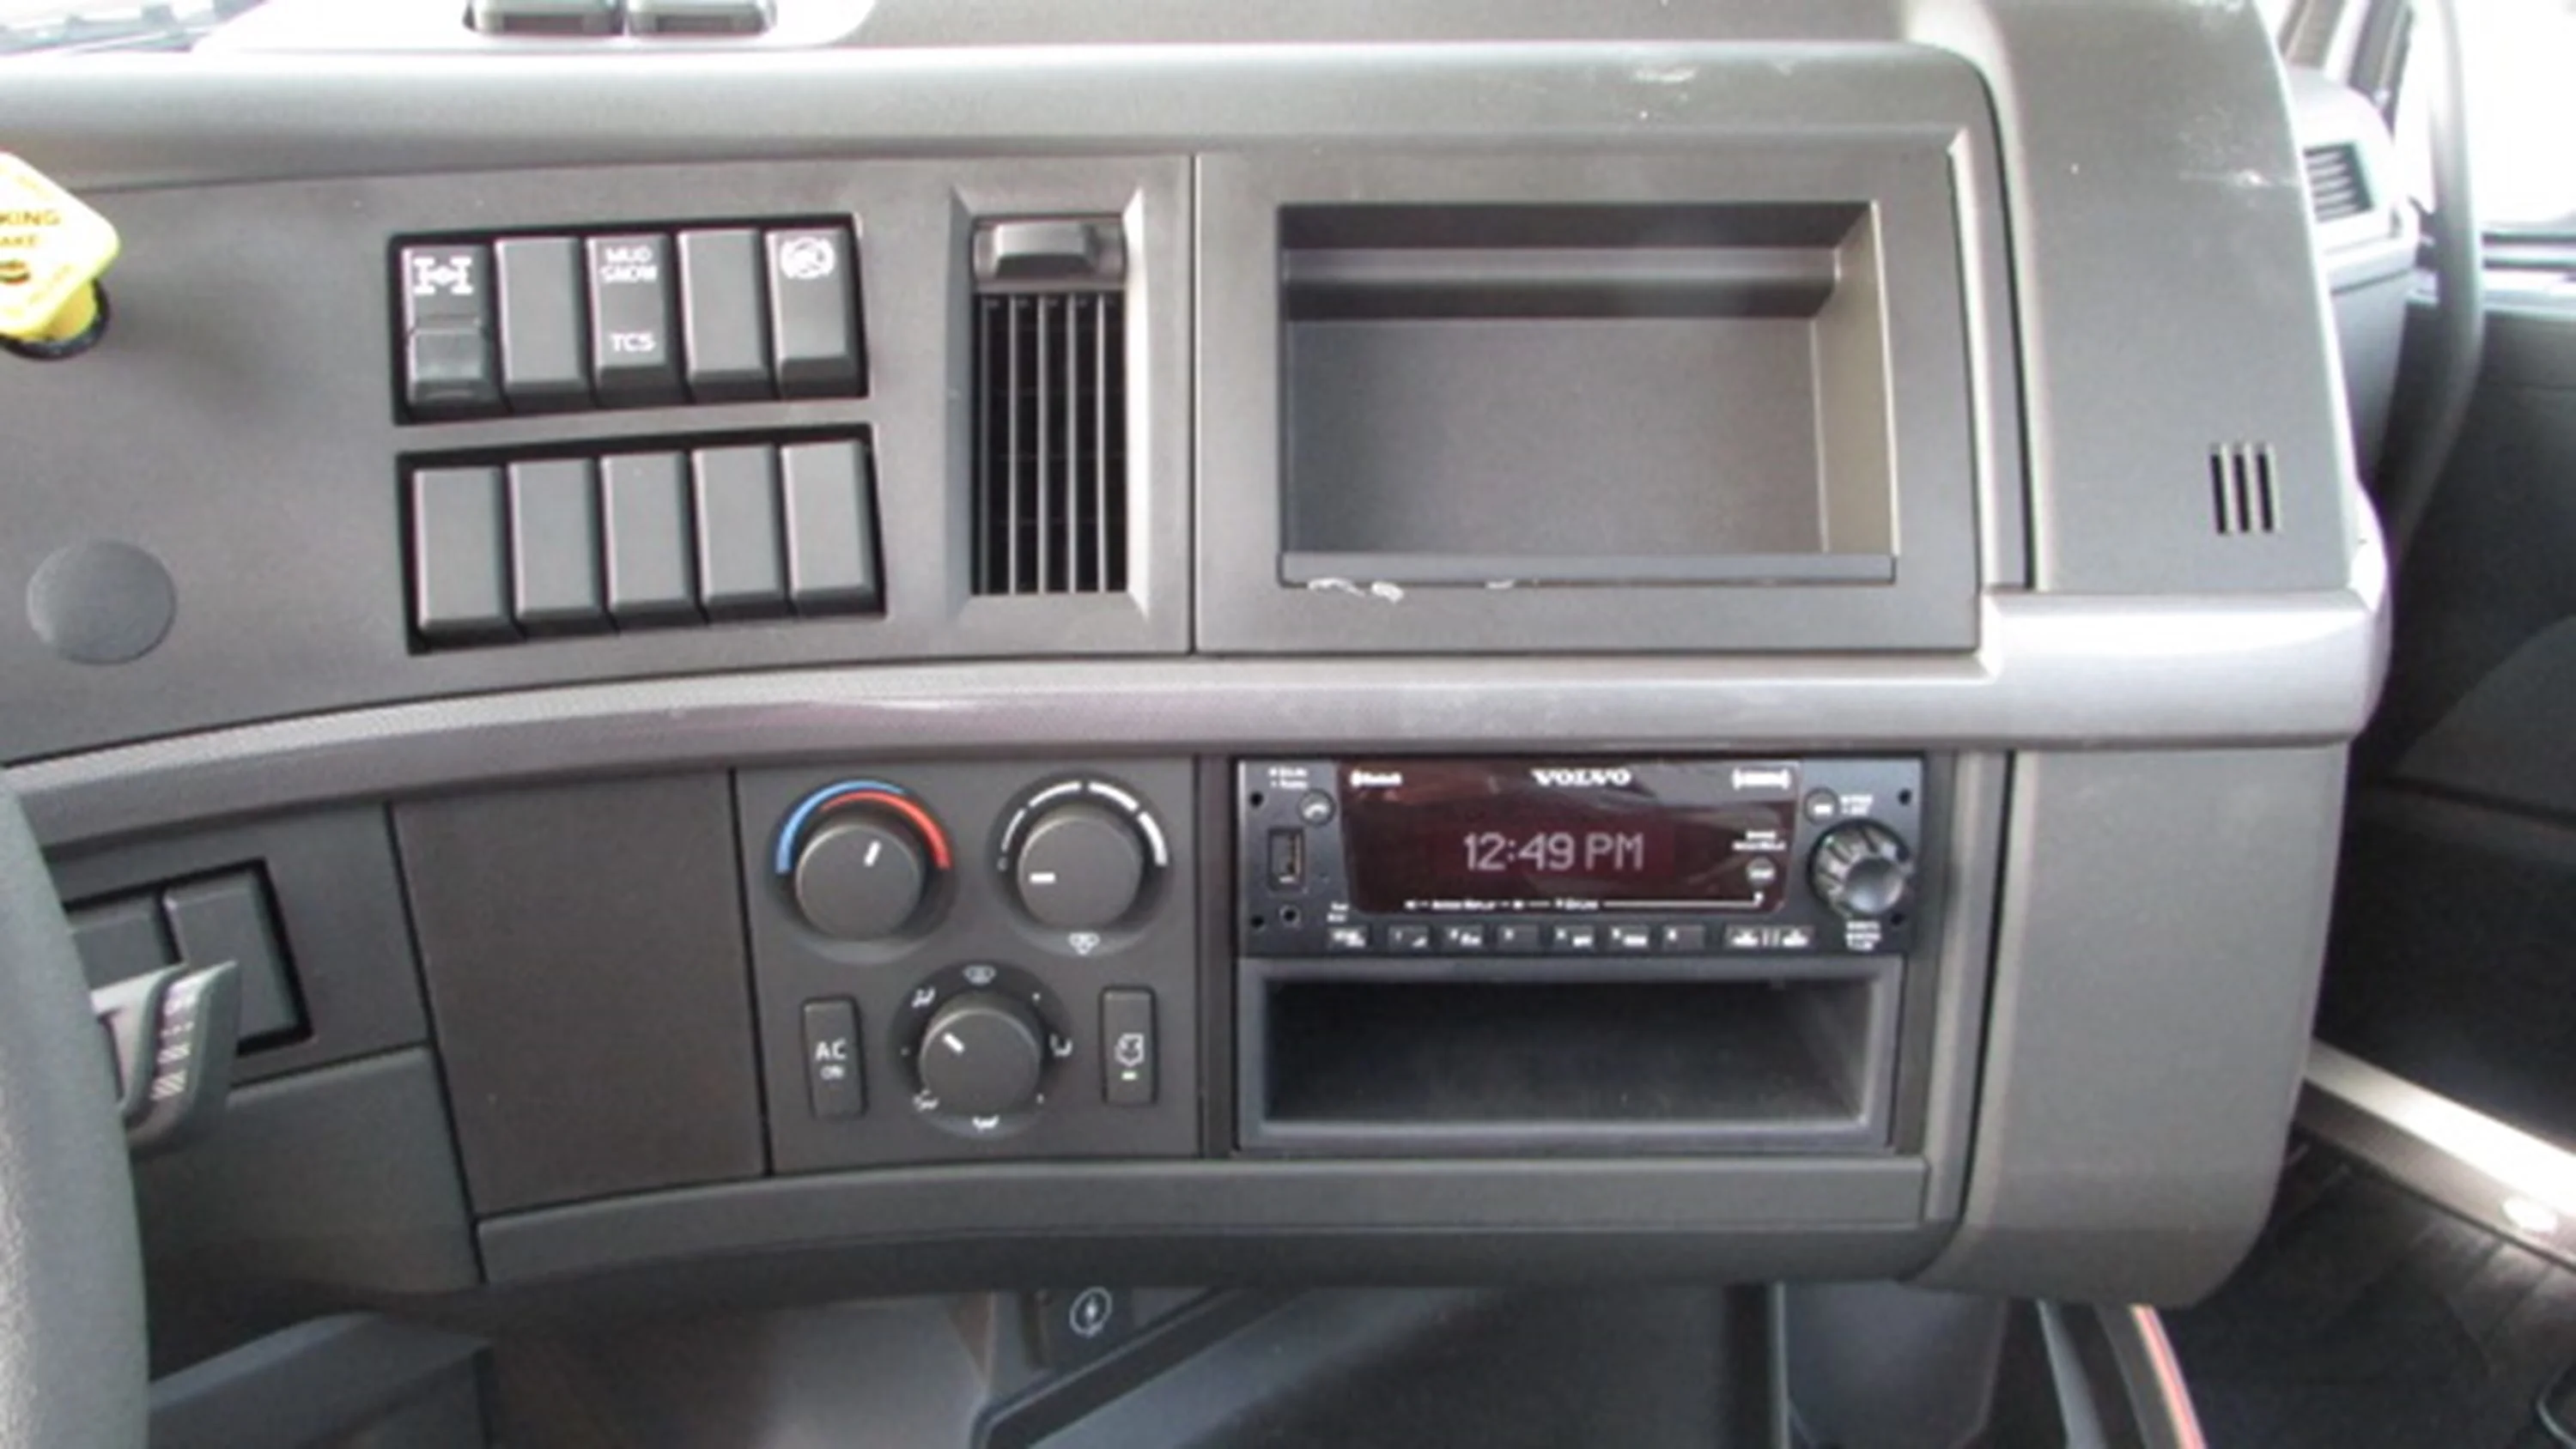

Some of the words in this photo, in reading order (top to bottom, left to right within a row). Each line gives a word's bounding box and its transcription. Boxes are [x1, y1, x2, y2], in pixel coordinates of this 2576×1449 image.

[605, 245, 653, 263] MUD
[598, 264, 658, 283] SNOW
[611, 331, 656, 352] TCS
[1532, 768, 1631, 785] VOLVO
[1463, 831, 1576, 871] 12:49
[1584, 831, 1644, 871] PM
[814, 1037, 848, 1061] AC
